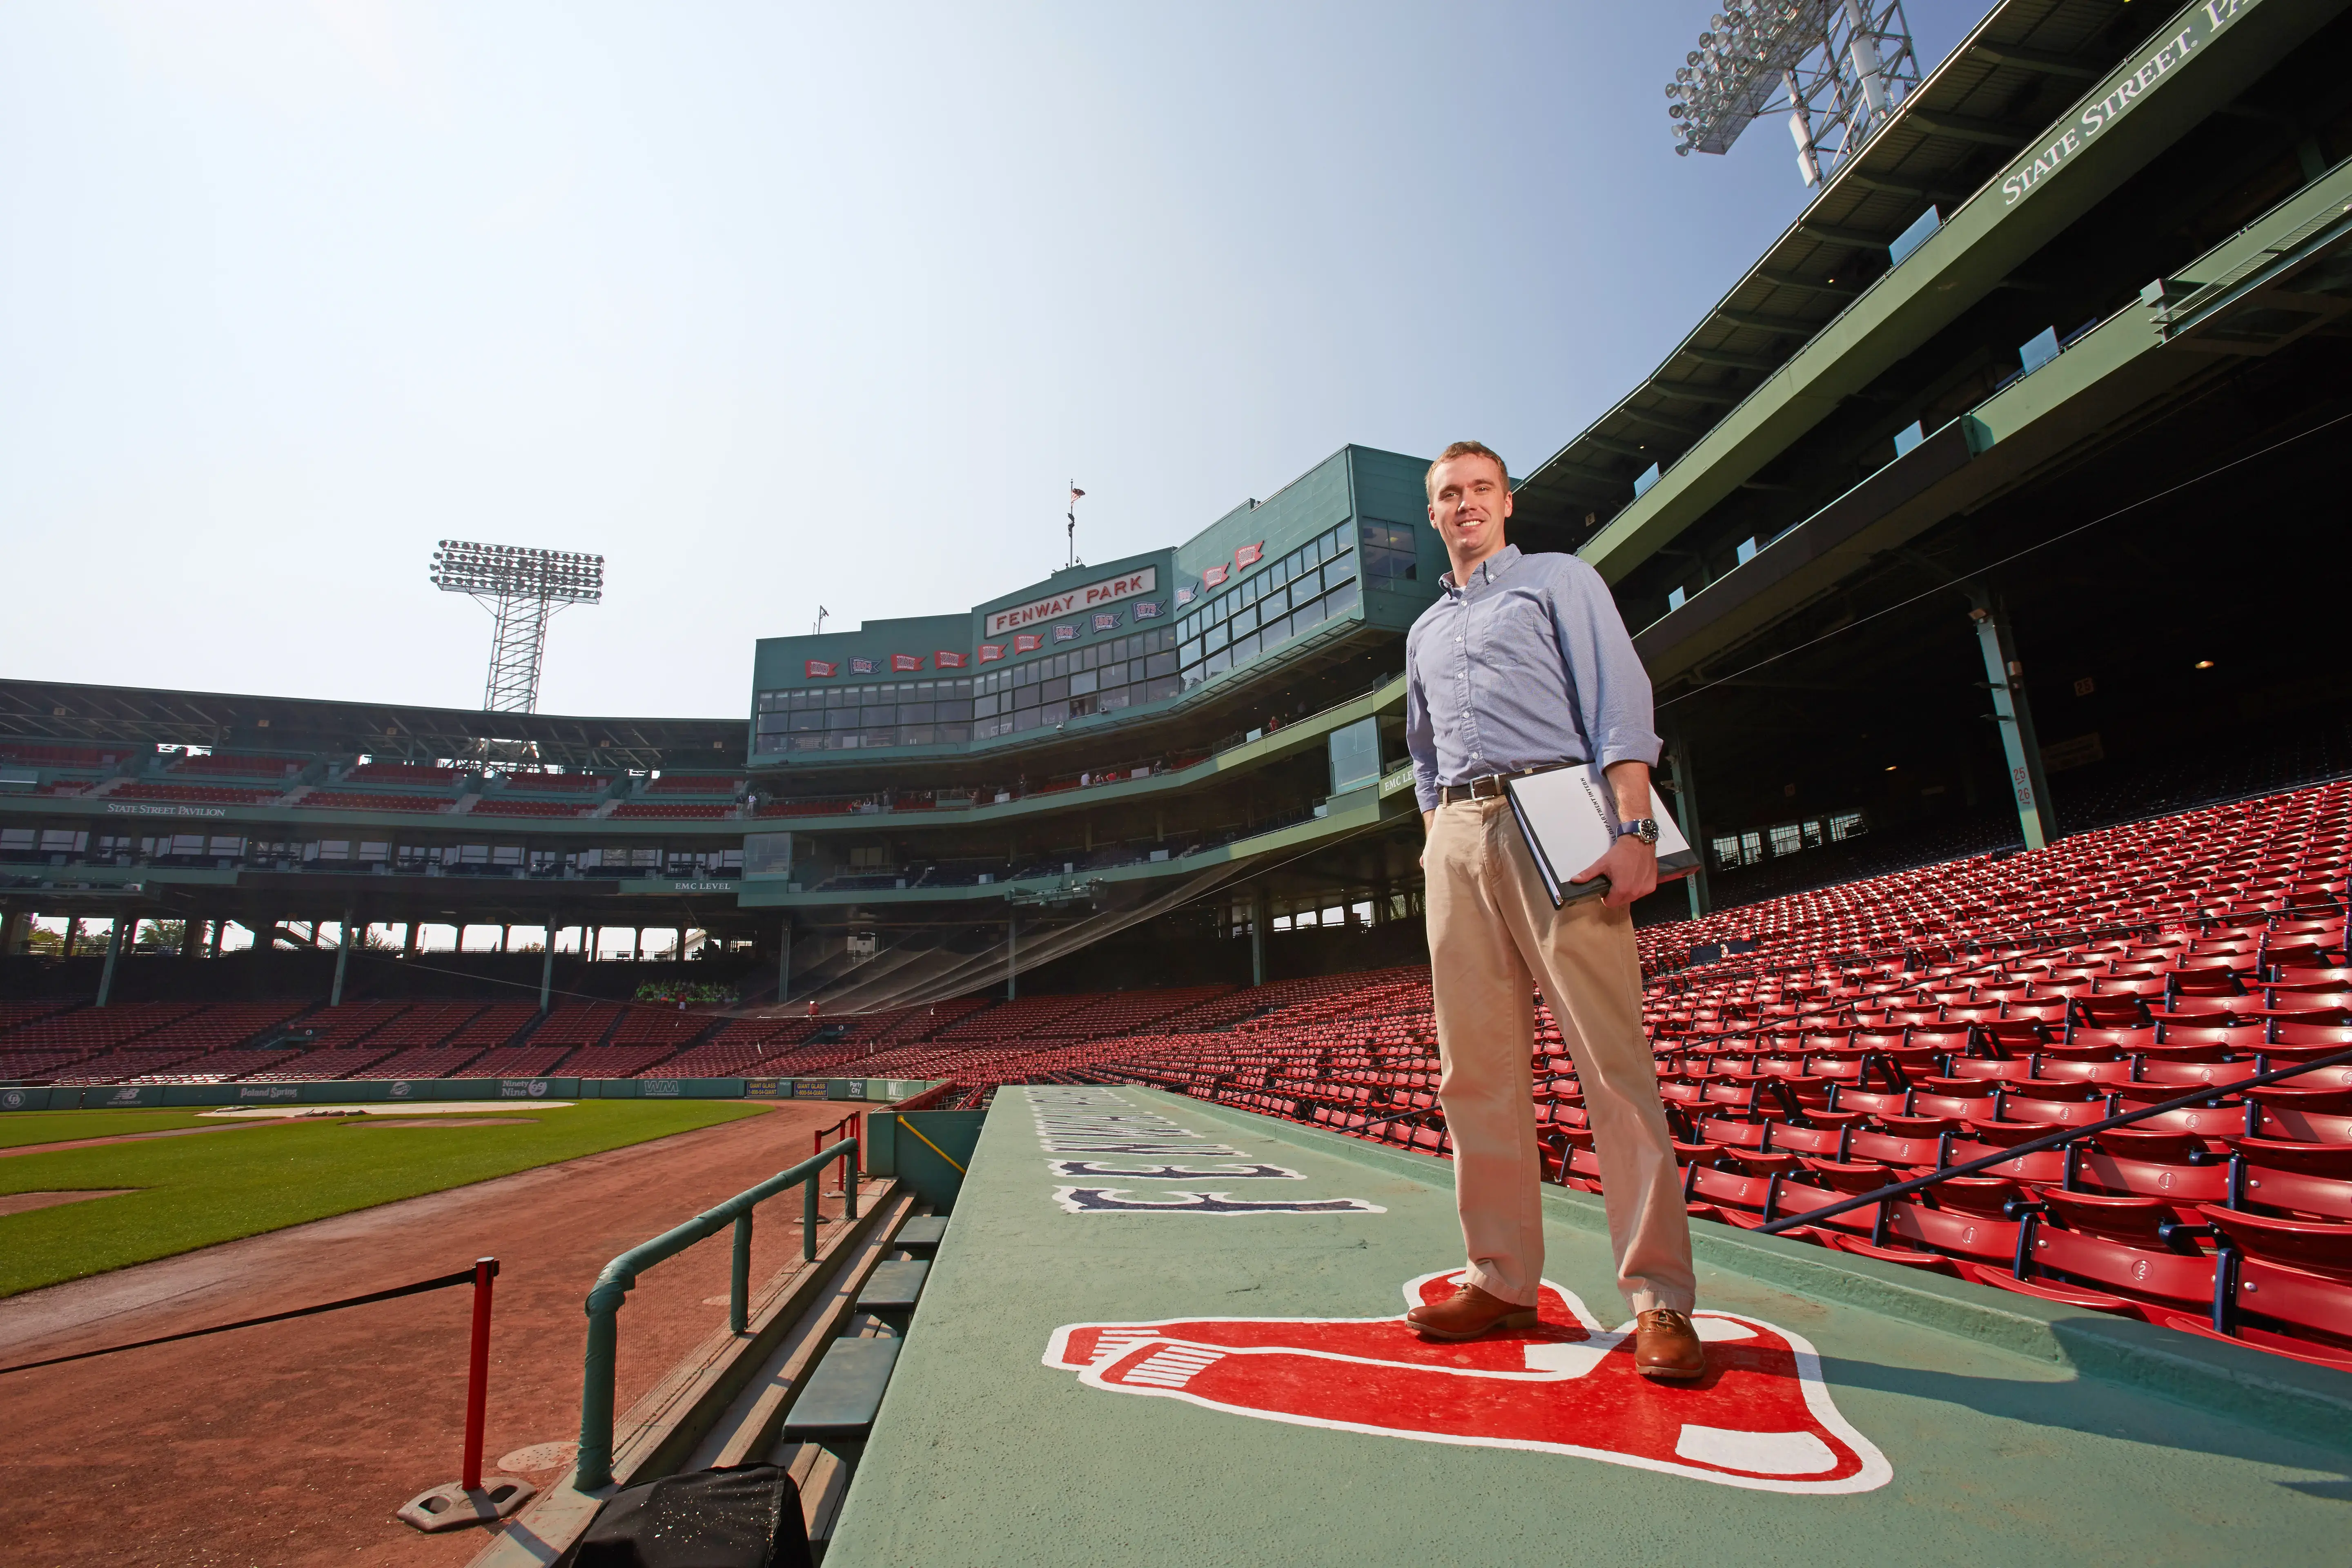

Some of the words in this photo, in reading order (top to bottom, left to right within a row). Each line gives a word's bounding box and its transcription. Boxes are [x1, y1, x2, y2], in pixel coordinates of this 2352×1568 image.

[2002, 128, 2080, 205] STATE
[1238, 549, 1256, 563] 2007
[1240, 558, 1254, 566] CHAMPIONS
[1207, 571, 1222, 582] 2004
[996, 595, 1074, 629] FENWAY
[1087, 575, 1143, 604] PARK
[1137, 606, 1156, 614] 1975
[1095, 617, 1114, 626] 1967
[1056, 628, 1073, 637] 1946
[897, 658, 915, 666] 1912
[940, 655, 959, 663] 1915
[811, 664, 829, 673] 1903
[853, 662, 872, 670] 1904
[2013, 767, 2026, 781] 25
[1385, 776, 1401, 791] EMC
[1402, 770, 1413, 783] LE
[1580, 777, 1594, 797] INTERN
[2018, 788, 2030, 801] 26
[108, 804, 137, 813] STATE
[139, 805, 176, 814] STREET
[178, 806, 226, 817] PAVILION
[1605, 796, 1616, 815] Thomson
[1591, 798, 1614, 835] DEPARTMENT
[644, 1080, 679, 1092] WM
[888, 1082, 904, 1096] WM
[240, 1087, 270, 1098] Poland
[270, 1087, 297, 1098] Spring
[501, 1088, 527, 1096] Nine
[2138, 1265, 2146, 1275] 2
